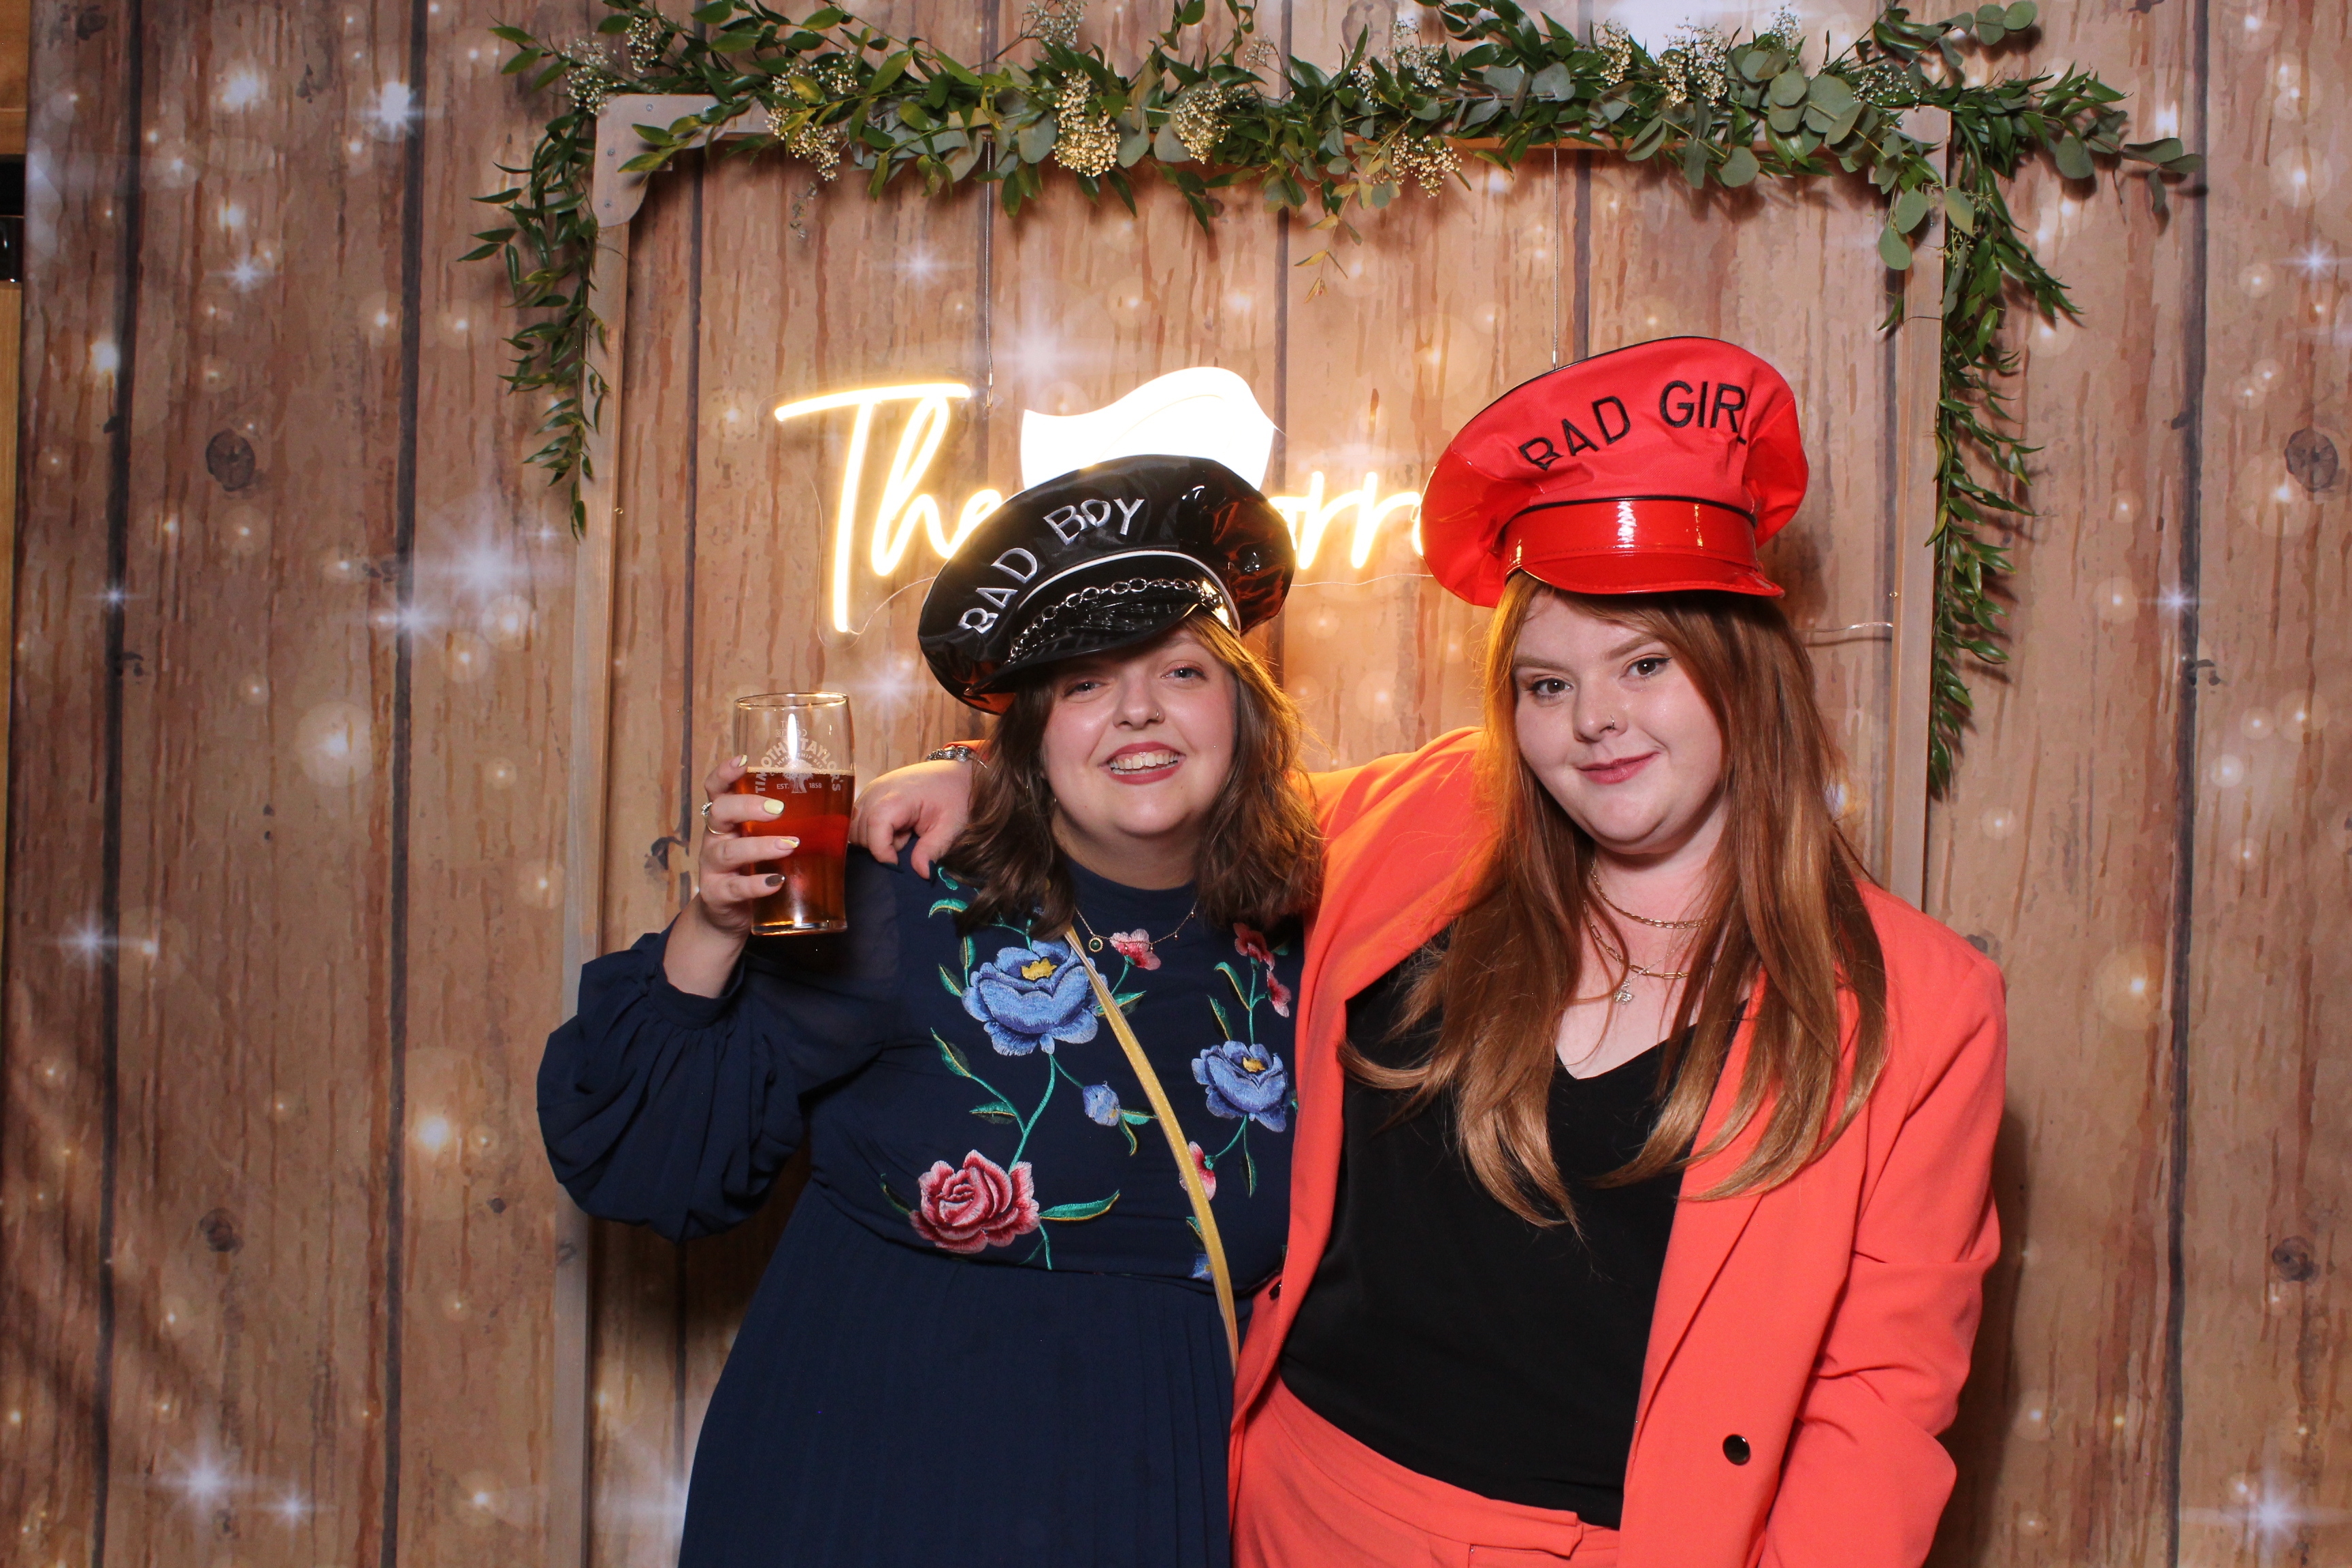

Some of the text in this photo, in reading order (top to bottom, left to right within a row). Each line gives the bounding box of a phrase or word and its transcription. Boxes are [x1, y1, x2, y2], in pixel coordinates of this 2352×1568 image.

[1518, 380, 1747, 470] BAD GIR
[958, 497, 1145, 634] BAD BOY
